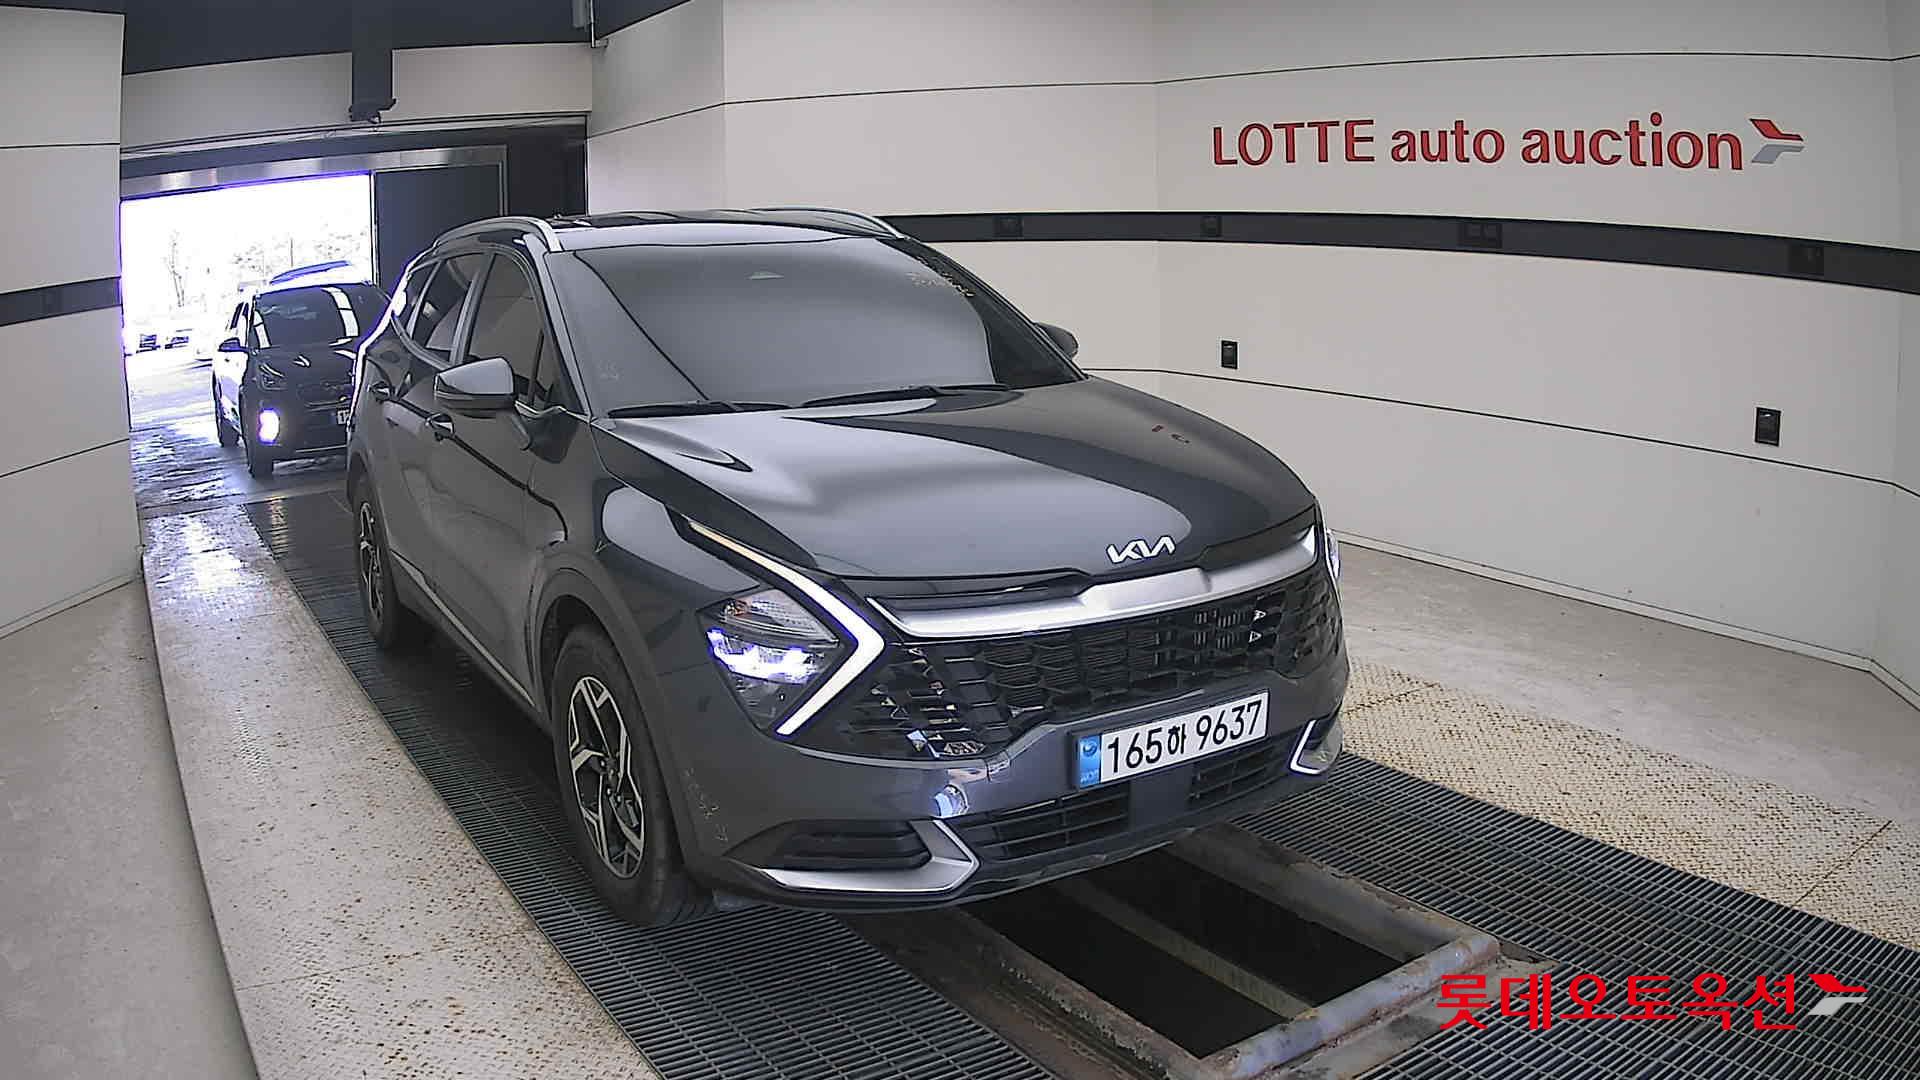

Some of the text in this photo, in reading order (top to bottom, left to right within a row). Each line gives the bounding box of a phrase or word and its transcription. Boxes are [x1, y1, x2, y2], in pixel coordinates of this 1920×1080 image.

[1213, 111, 1743, 171] LOTTE auto auction
[1107, 699, 1263, 774] 165하 9637
